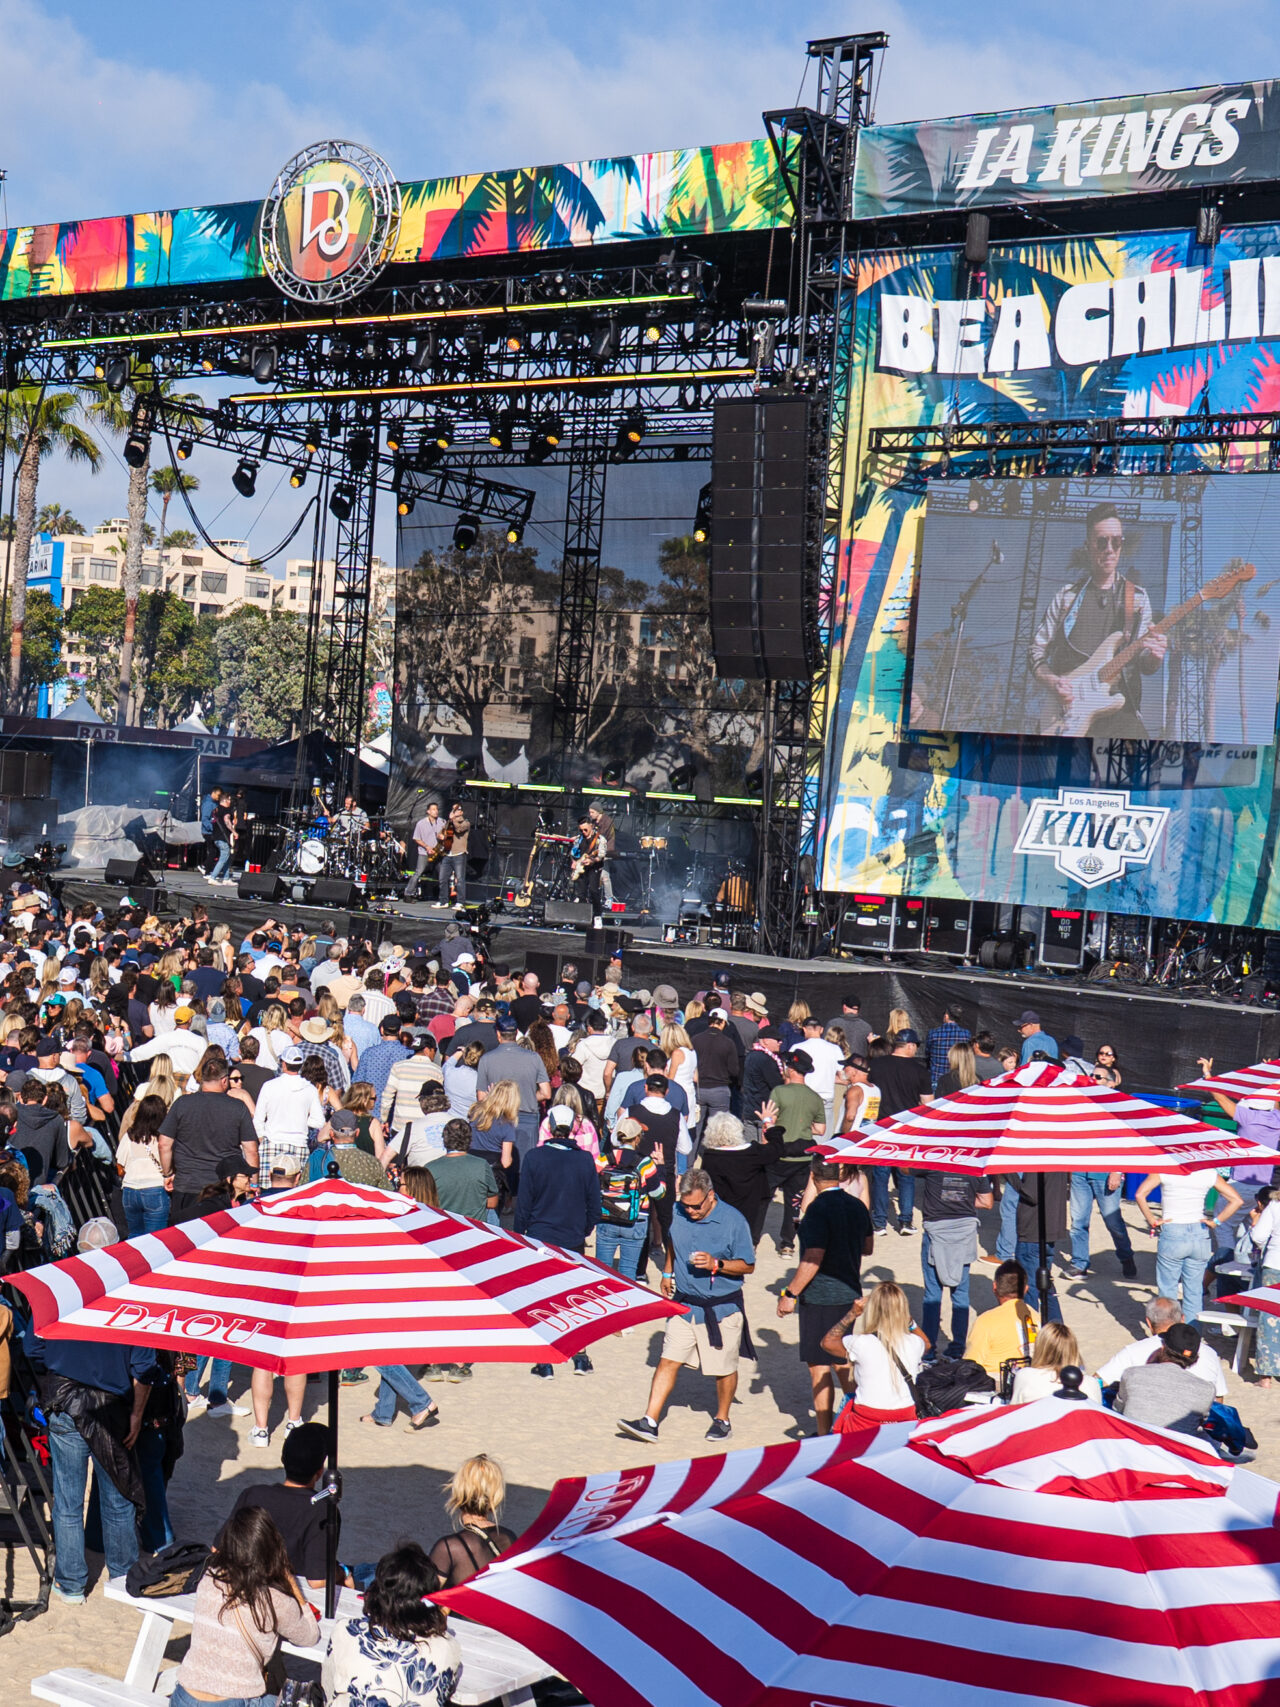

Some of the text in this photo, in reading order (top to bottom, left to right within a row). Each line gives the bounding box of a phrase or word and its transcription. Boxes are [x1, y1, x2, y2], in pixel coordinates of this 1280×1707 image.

[958, 124, 1034, 189] LA
[1037, 98, 1250, 187] KINGS
[29, 558, 48, 574] ARINA
[80, 726, 116, 741] BAR
[193, 738, 229, 755] BAR
[1226, 750, 1258, 760] CLUB
[1069, 797, 1120, 809] Los Angeles
[1031, 809, 1154, 852] KINGS
[869, 1142, 980, 1163] DAOU
[1165, 1139, 1251, 1161] DAOU
[526, 1284, 631, 1333] DAOU
[104, 1303, 267, 1345] DAOU
[550, 1475, 645, 1541] DAO
